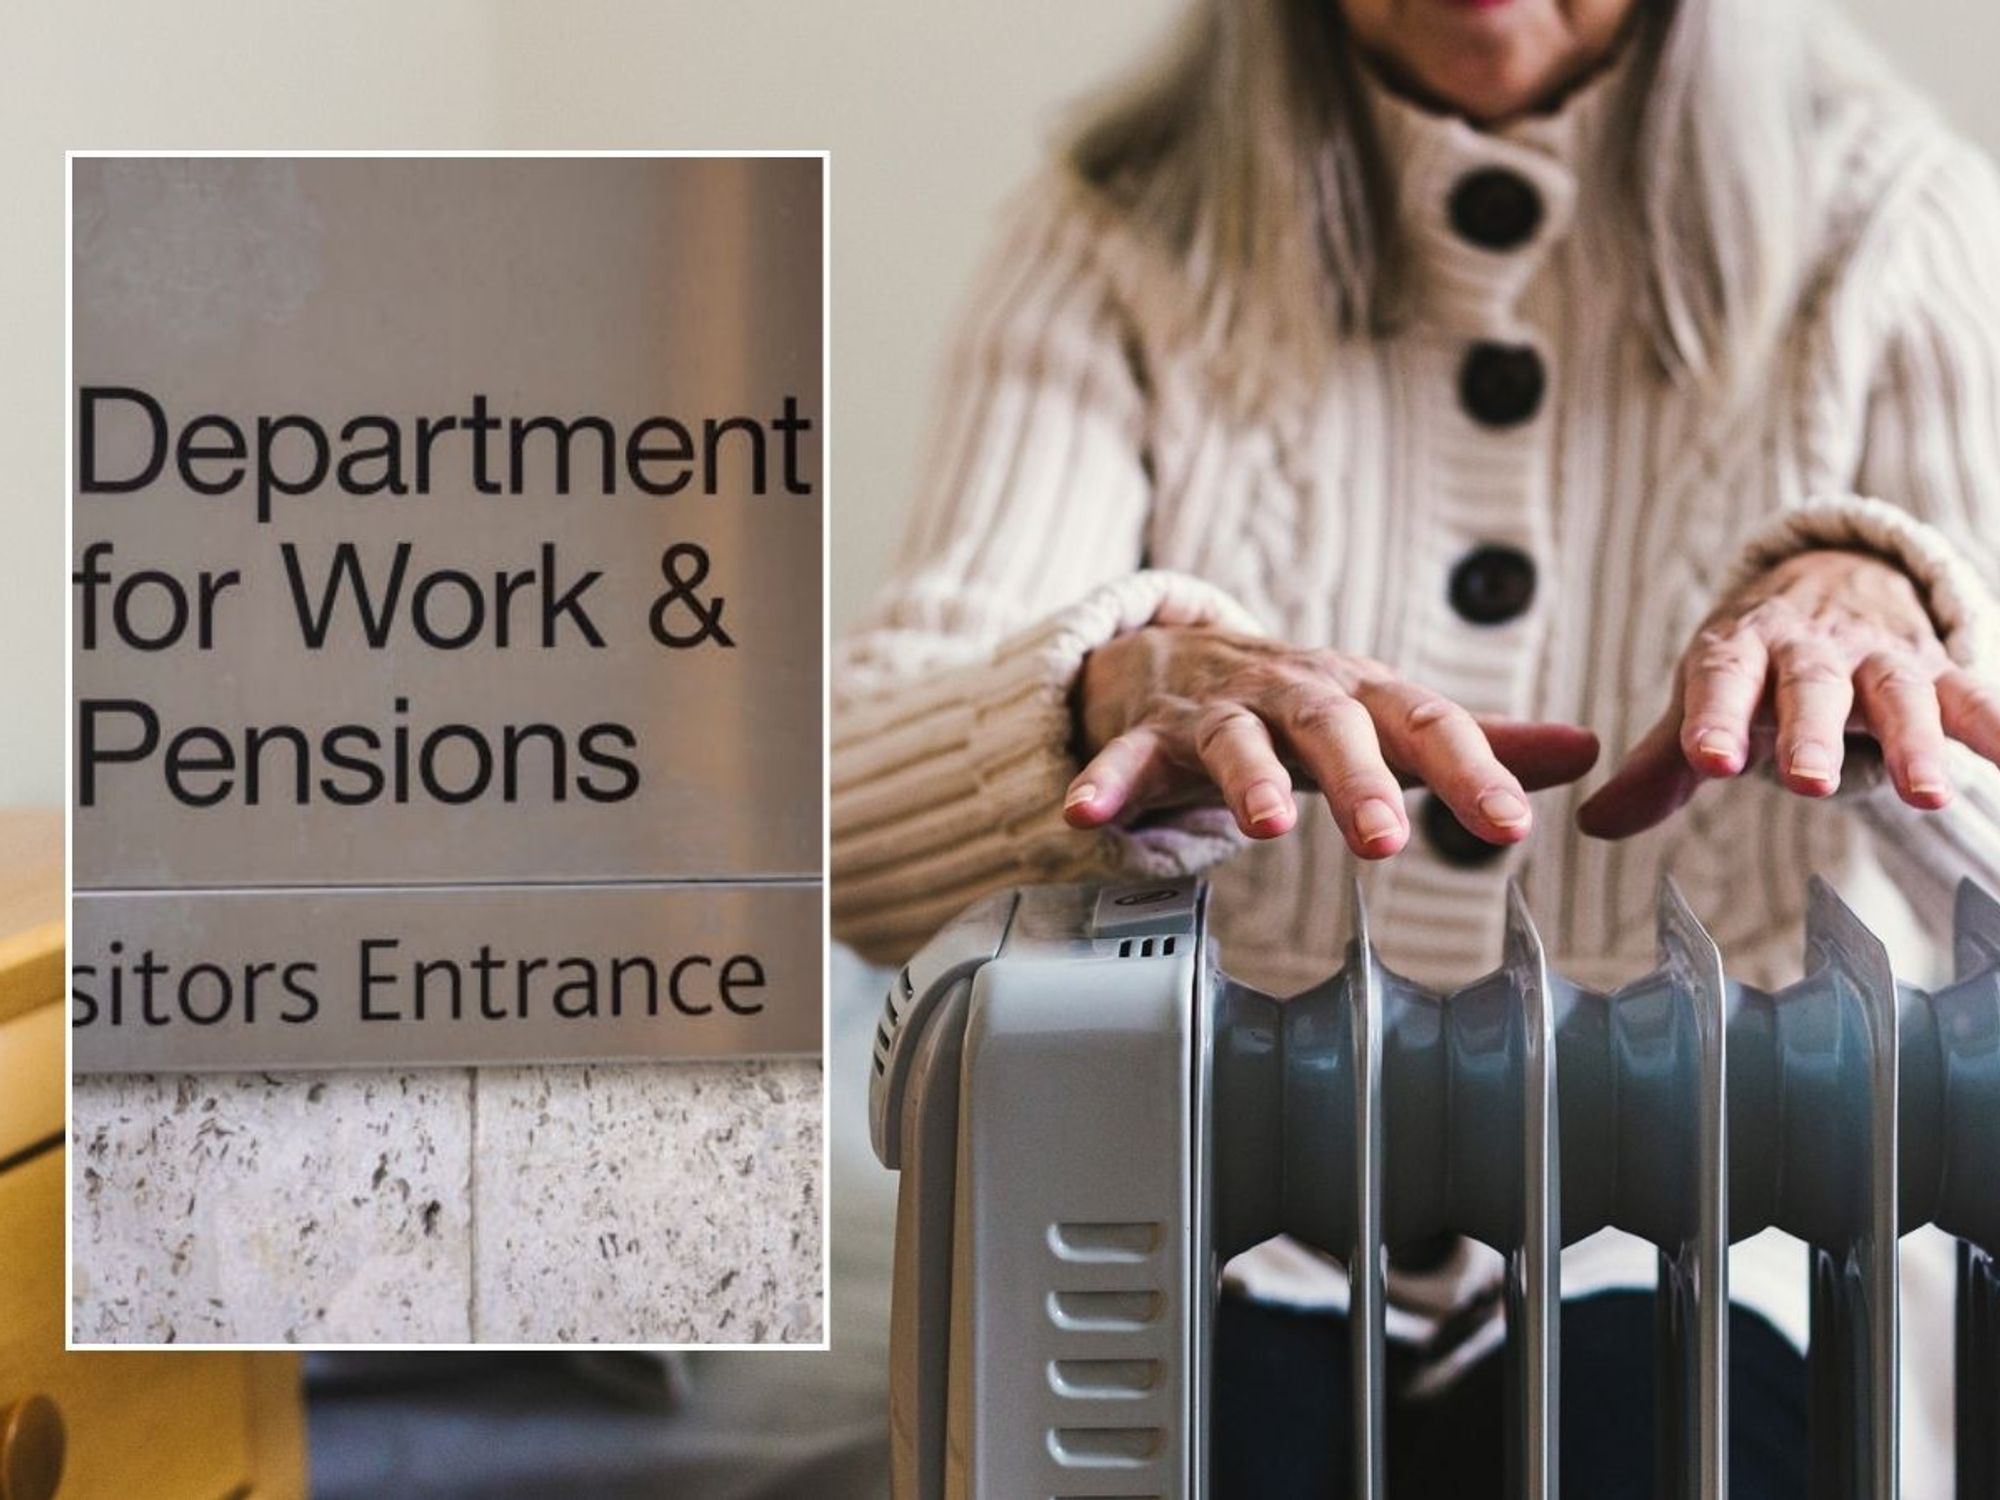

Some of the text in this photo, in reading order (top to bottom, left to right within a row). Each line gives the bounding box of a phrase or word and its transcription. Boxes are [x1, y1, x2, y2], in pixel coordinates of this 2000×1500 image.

[78, 386, 812, 523] Department
[72, 541, 736, 650] for Work &
[78, 697, 641, 807] Pensions
[72, 938, 767, 1027] sitors Entrance
